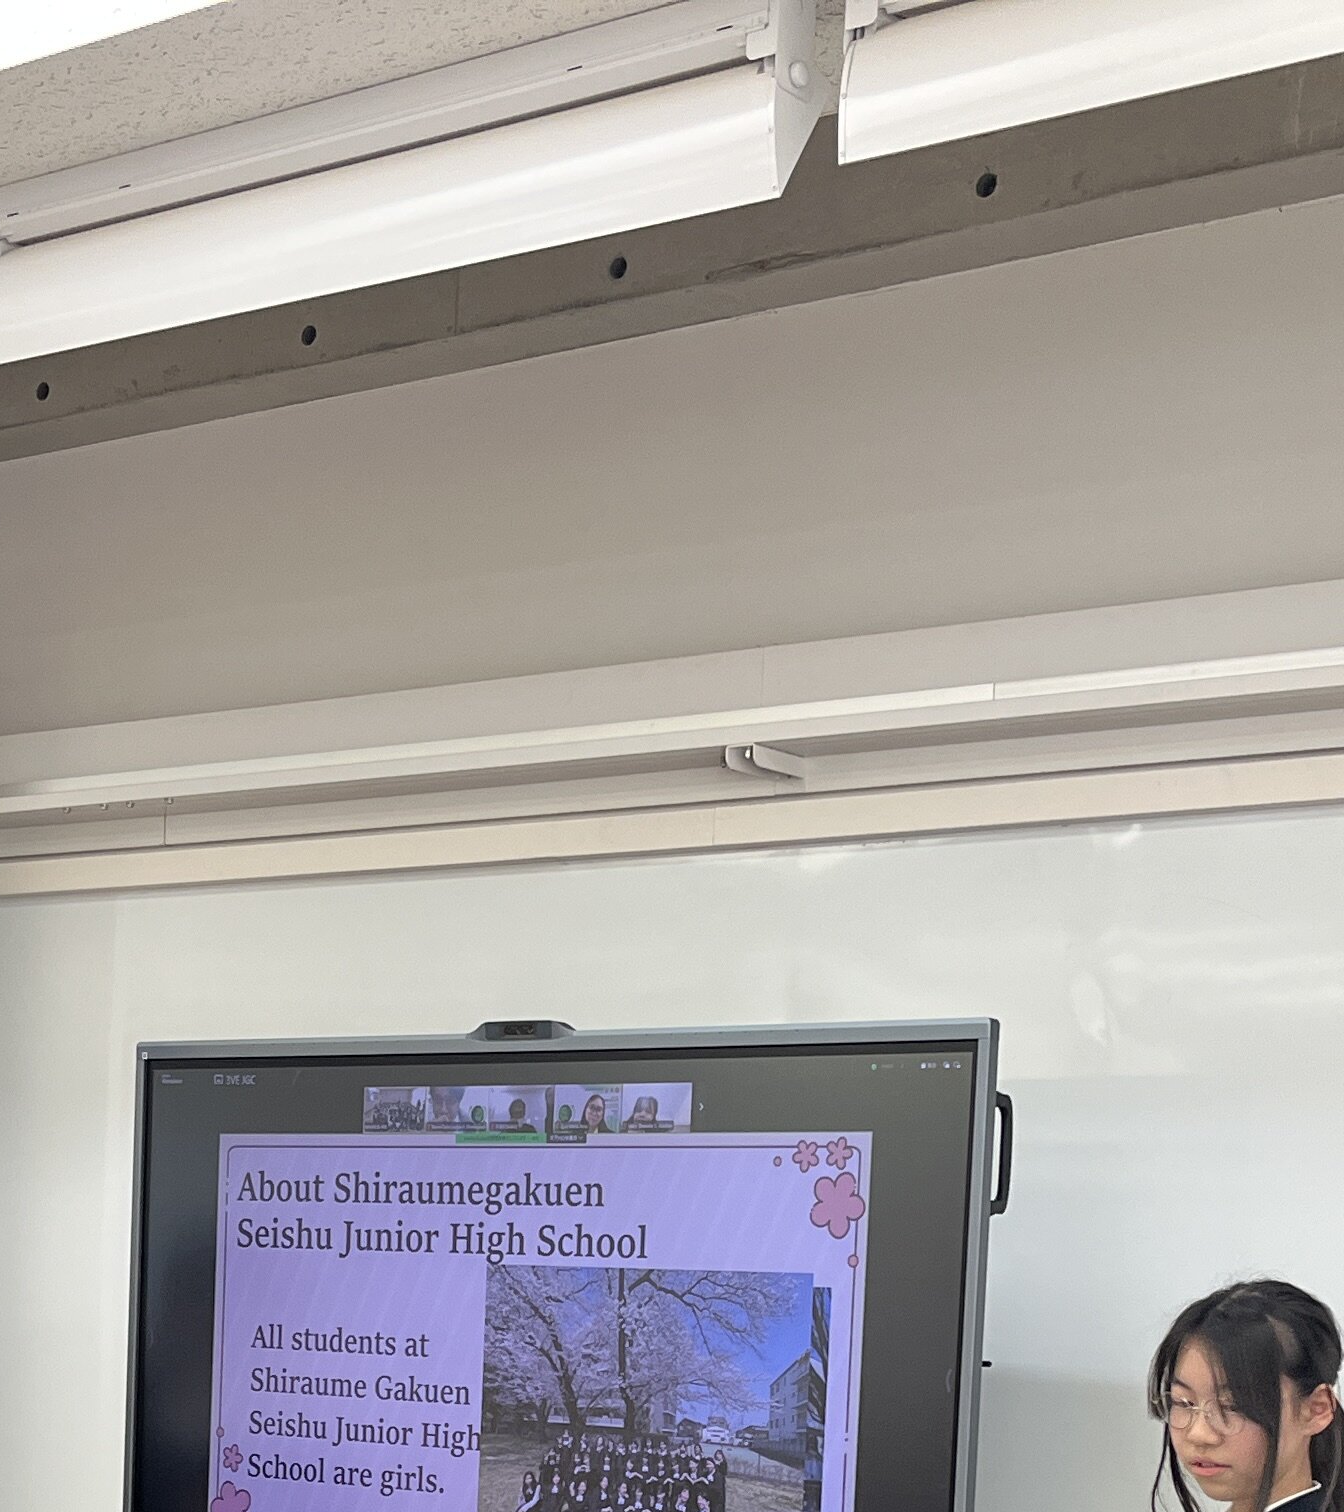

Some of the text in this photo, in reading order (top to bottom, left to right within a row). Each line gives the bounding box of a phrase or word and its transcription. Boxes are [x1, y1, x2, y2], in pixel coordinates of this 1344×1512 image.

[236, 1171, 605, 1216] About Shiraumegakuen
[236, 1217, 648, 1265] Seishu Junior High School
[250, 1323, 430, 1358] All students at
[250, 1367, 471, 1406] Shiraume Gakuen
[248, 1410, 481, 1458] Seishu Junior High
[247, 1453, 445, 1497] School are girls.
